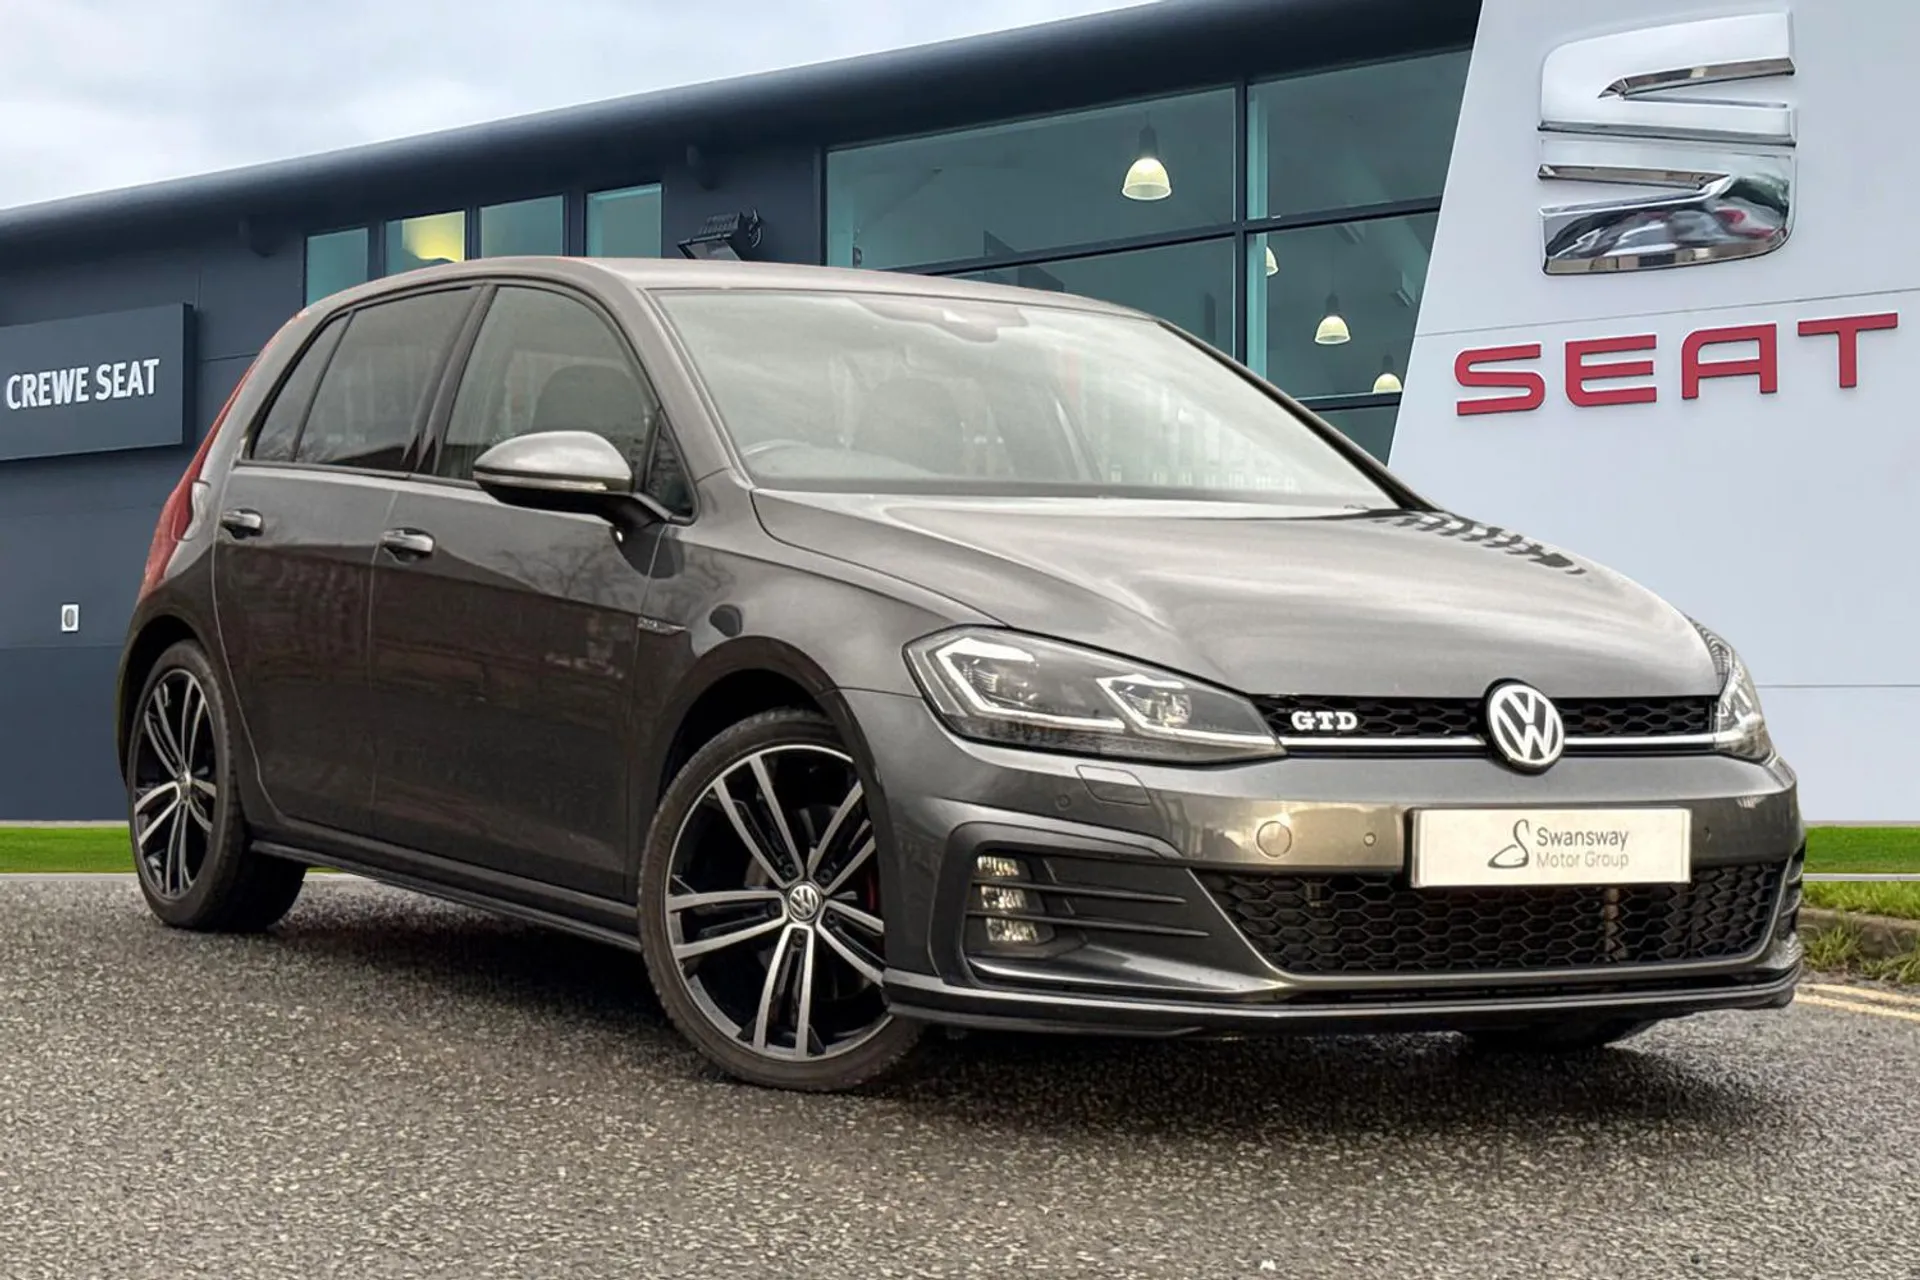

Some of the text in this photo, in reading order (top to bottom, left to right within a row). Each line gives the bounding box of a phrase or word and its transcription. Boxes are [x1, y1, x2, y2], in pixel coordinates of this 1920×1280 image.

[1455, 312, 1898, 416] SEAT
[6, 358, 160, 409] CREWE SEAT
[1291, 711, 1357, 730] GTD
[1536, 826, 1629, 852] Swansway
[1536, 850, 1629, 869] Motor Group
